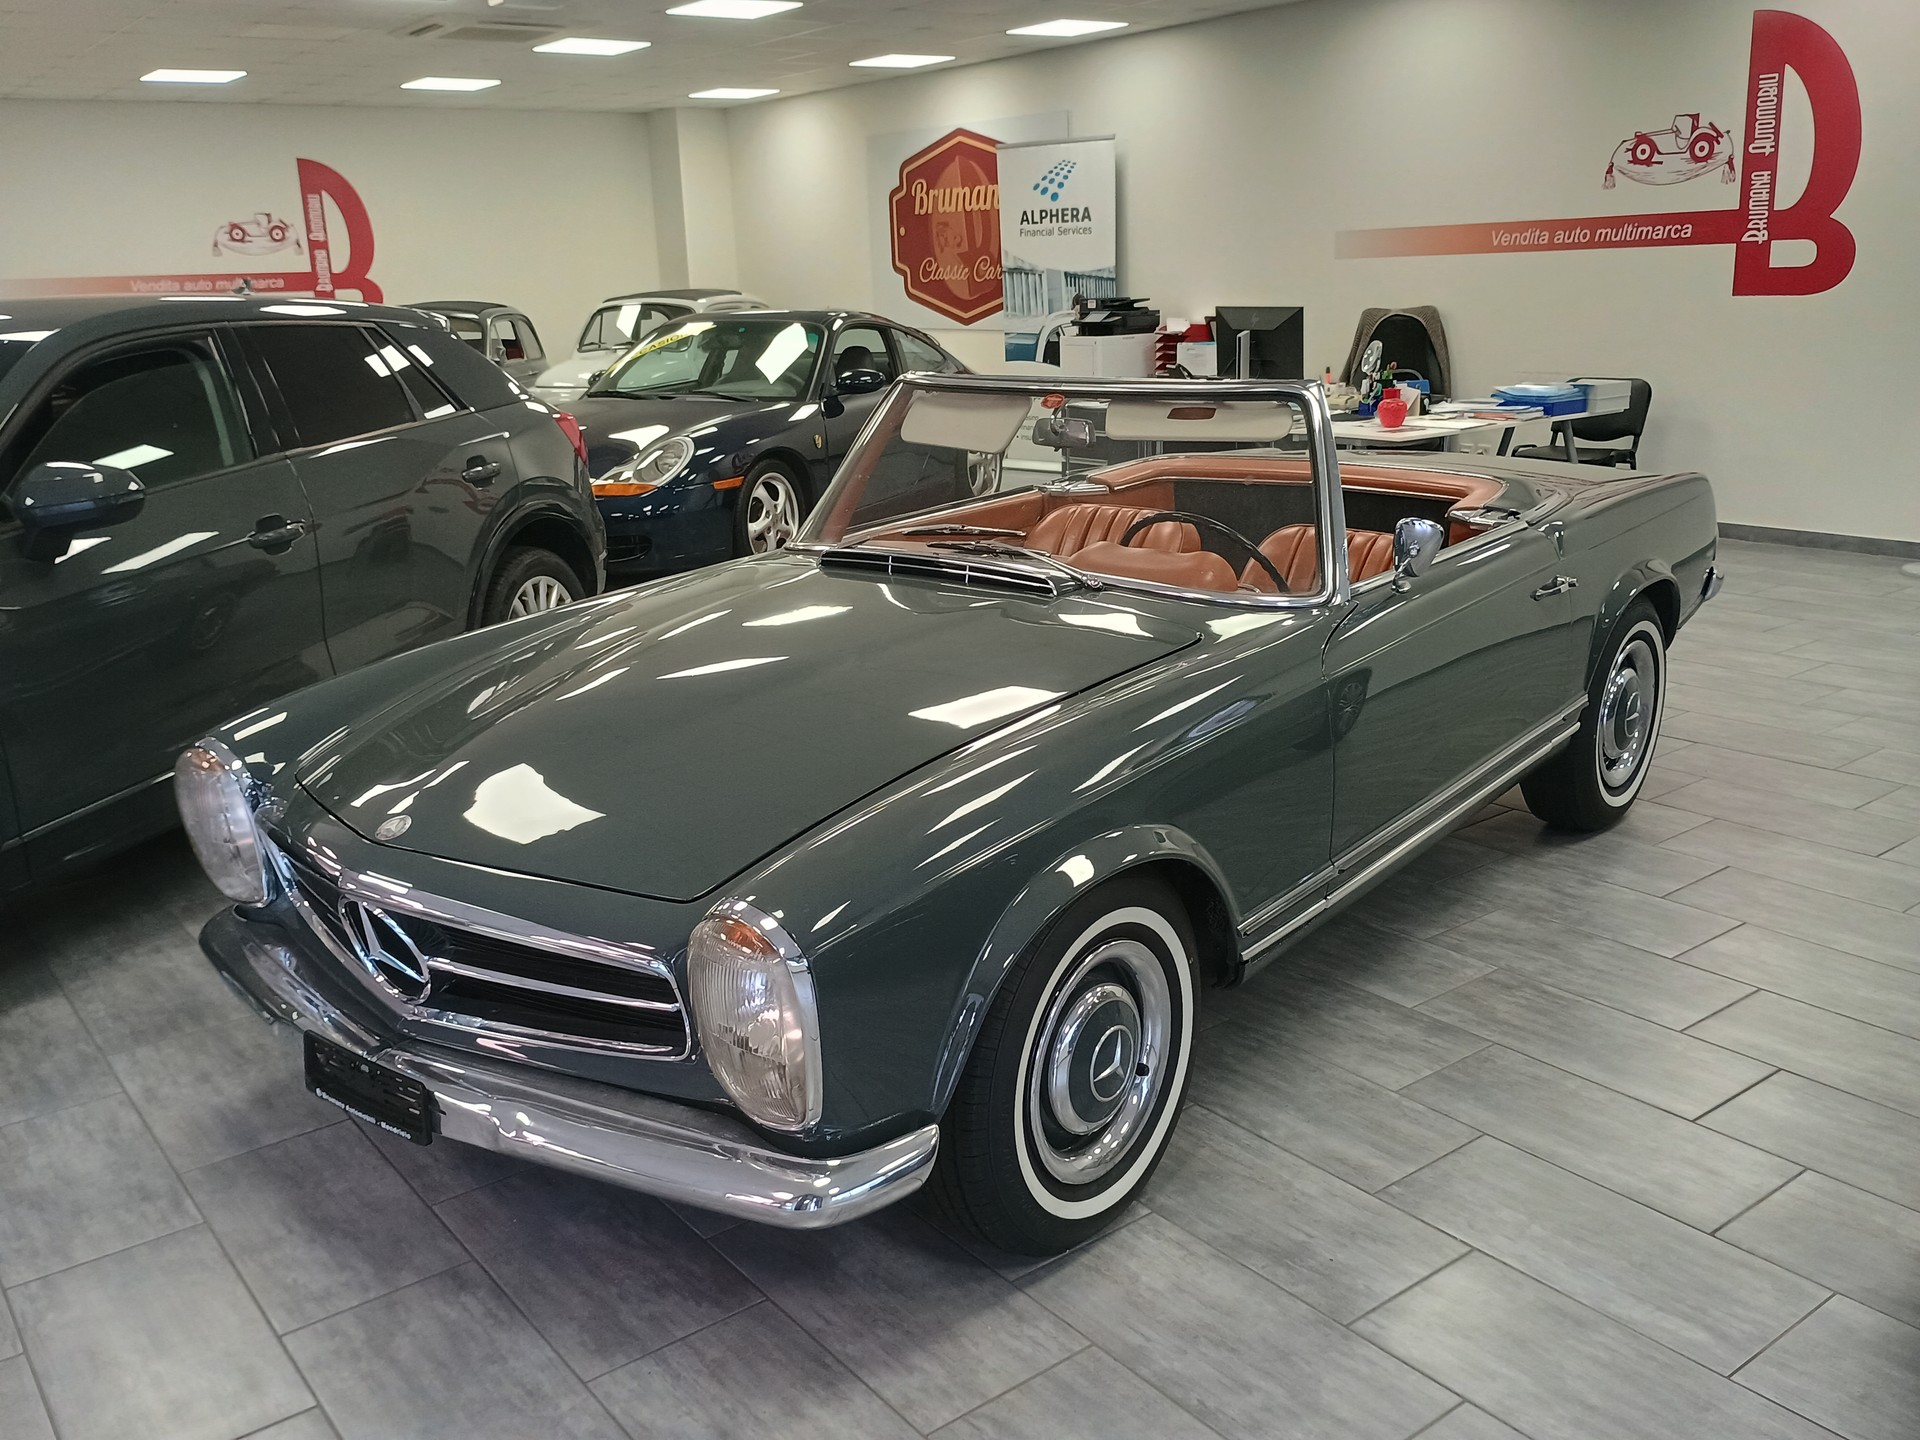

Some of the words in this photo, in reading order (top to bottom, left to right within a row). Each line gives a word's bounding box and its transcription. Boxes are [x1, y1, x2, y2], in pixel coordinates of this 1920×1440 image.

[1019, 206, 1092, 226] ALPHERA
[1019, 226, 1055, 237] Financial
[1057, 225, 1093, 236] Services
[1491, 229, 1550, 247] Vendita
[1553, 226, 1591, 244] auto
[1594, 222, 1694, 243] multimarca
[919, 257, 971, 283] Classic
[130, 278, 181, 292] Vendita
[183, 278, 213, 291] auto
